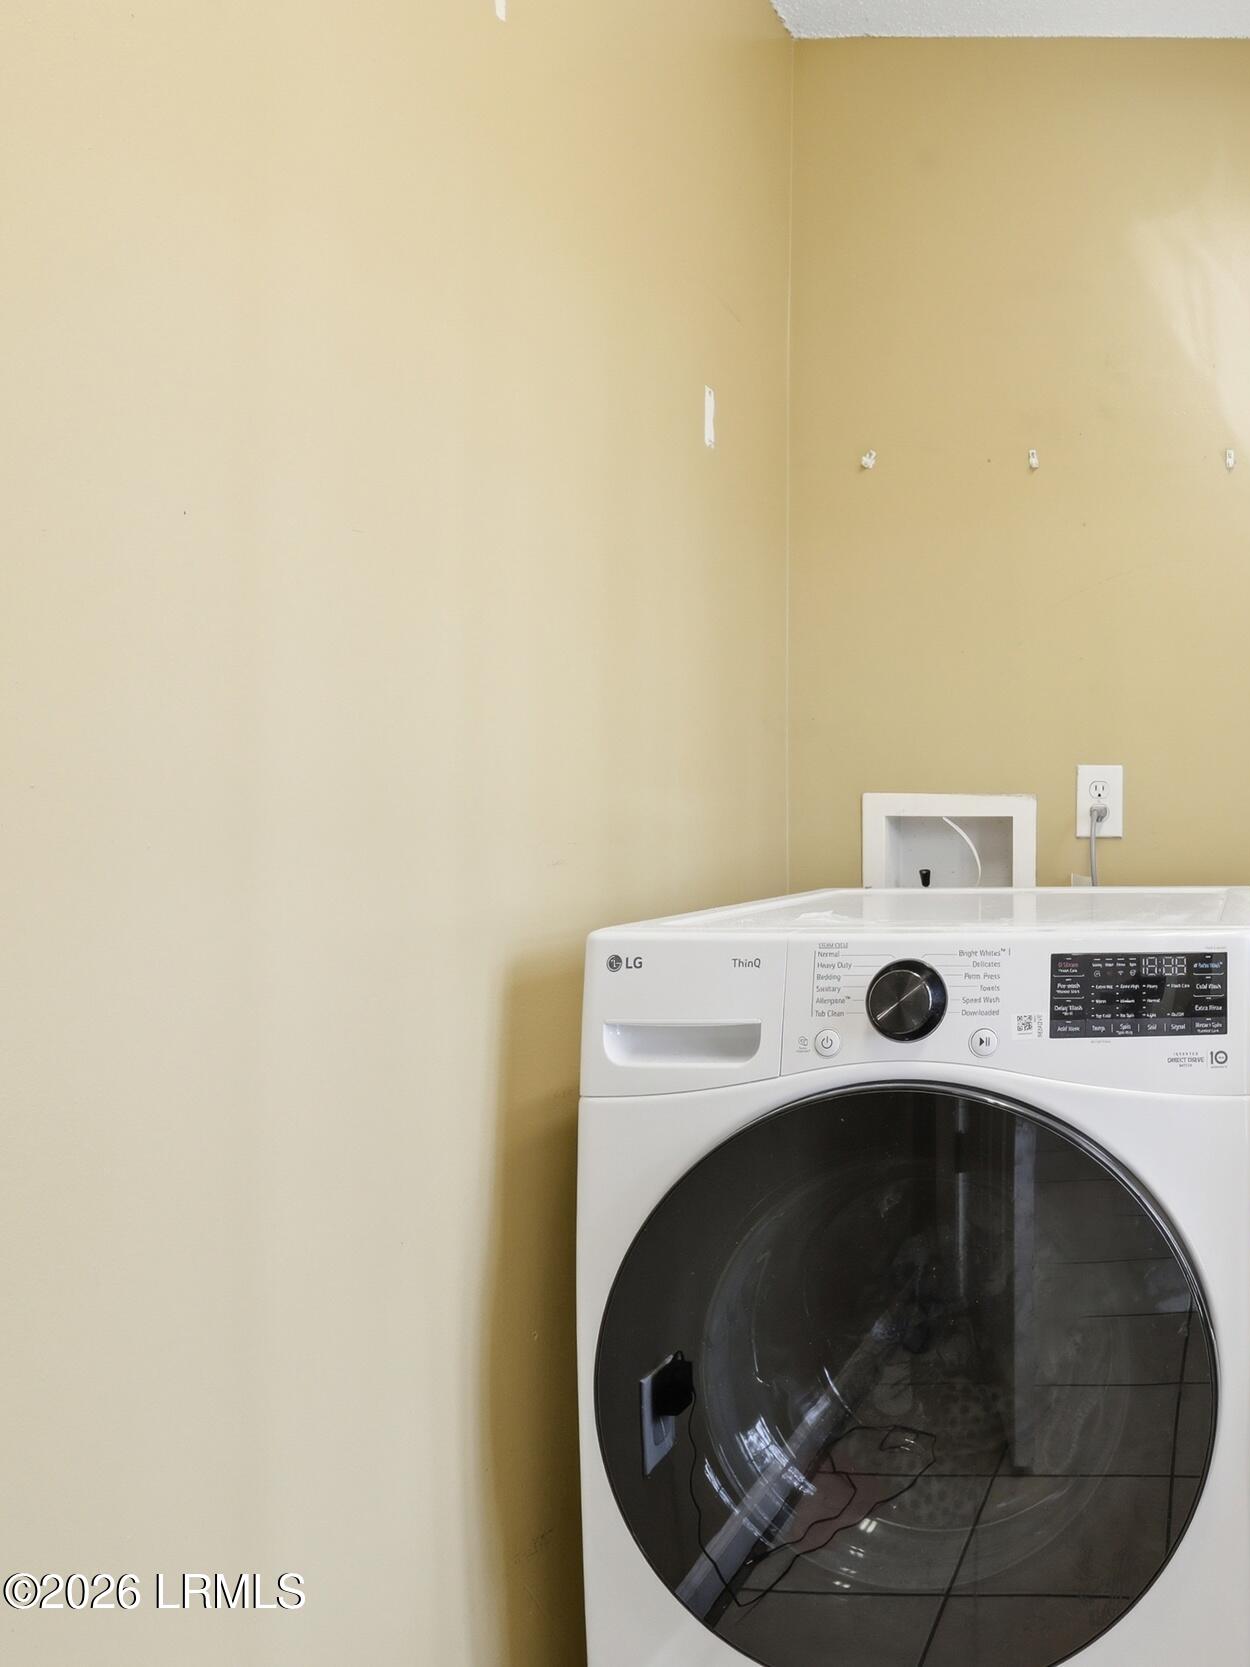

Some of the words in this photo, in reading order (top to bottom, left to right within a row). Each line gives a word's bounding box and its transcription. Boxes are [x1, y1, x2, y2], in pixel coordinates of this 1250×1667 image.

[959, 949, 978, 958] Bright
[625, 956, 643, 969] LG
[732, 957, 761, 969] ThinQ
[817, 962, 836, 970] Heavy
[837, 962, 853, 970] Duty
[972, 960, 1001, 968] Delicates
[816, 974, 841, 982] Bedding
[983, 972, 1001, 980] Press
[816, 985, 841, 994] Sanitary
[979, 984, 1001, 992] Towels
[962, 996, 981, 1004] Speed
[961, 1009, 1000, 1017] Downloaded
[1210, 1050, 1228, 1065] 10
